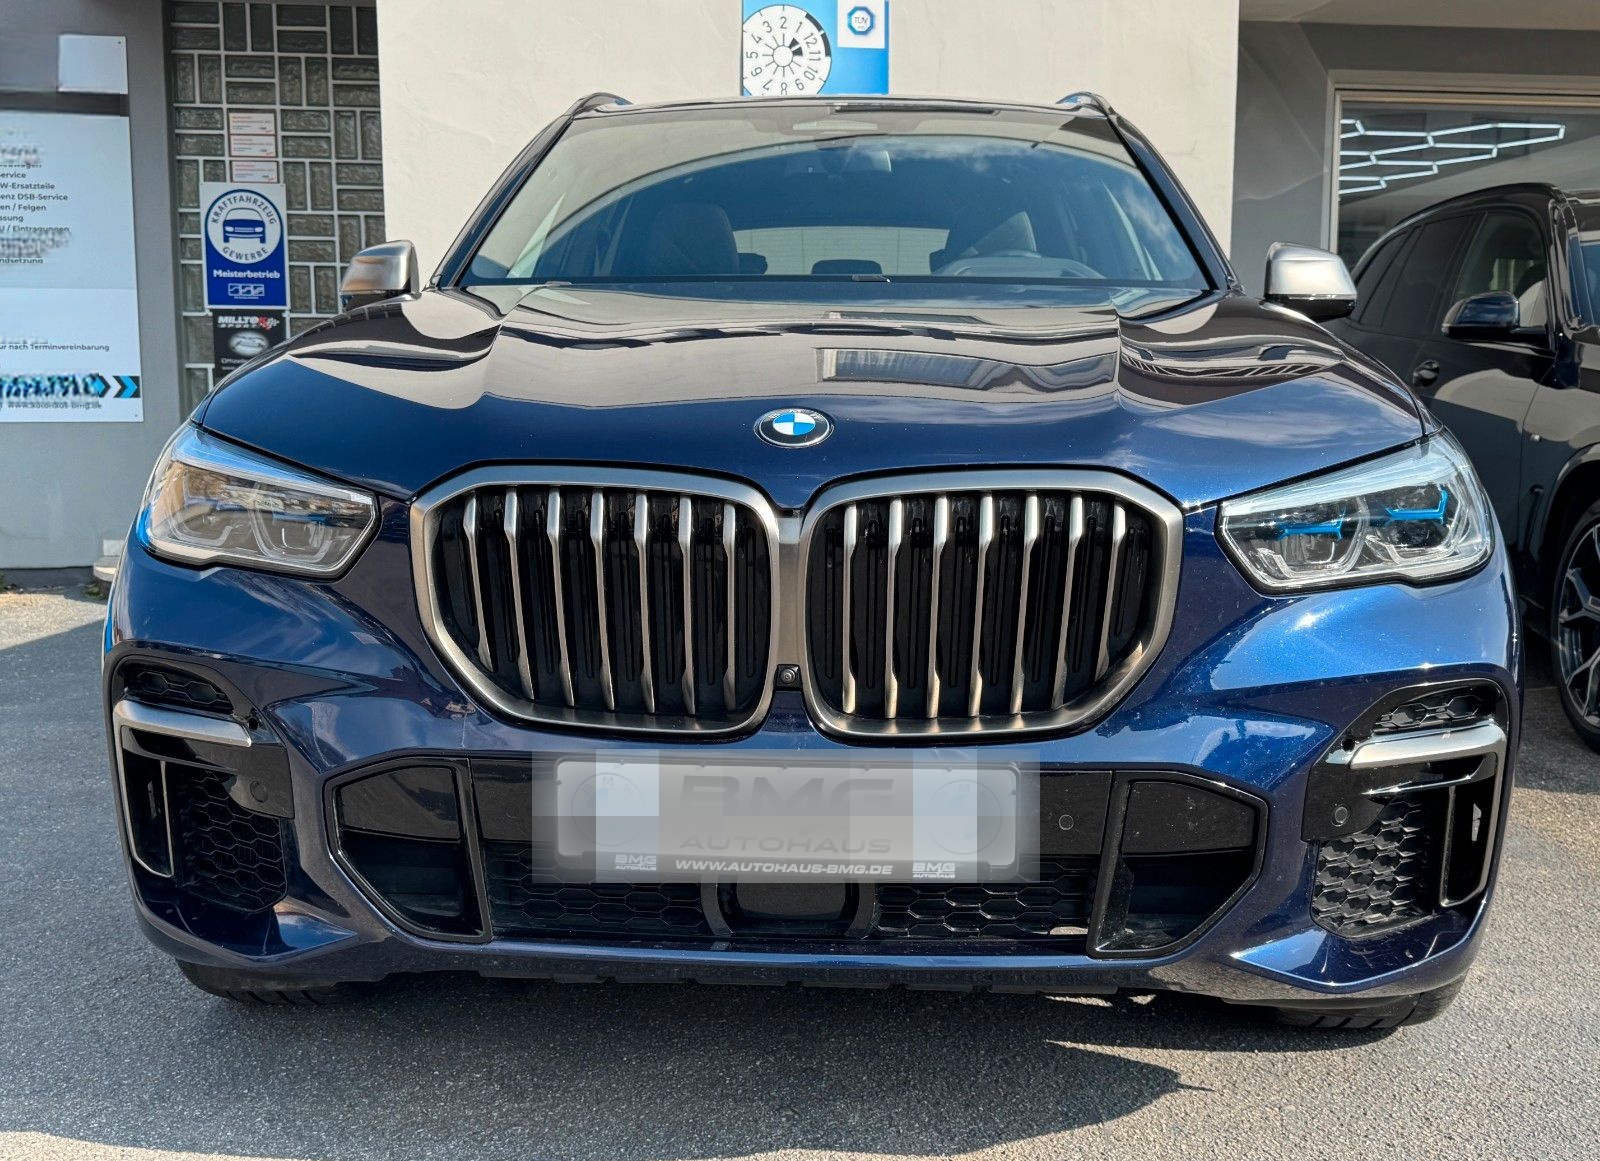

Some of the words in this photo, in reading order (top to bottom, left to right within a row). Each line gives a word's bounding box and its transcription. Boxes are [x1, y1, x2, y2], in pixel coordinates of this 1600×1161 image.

[763, 20, 773, 33] 3
[780, 16, 788, 29] 2
[796, 21, 803, 33] 1
[751, 33, 763, 44] 4
[803, 32, 818, 49] 12
[746, 51, 759, 59] 5
[809, 51, 821, 62] 11
[751, 66, 763, 77] 6
[803, 65, 818, 81] 10
[762, 79, 773, 91] 7
[780, 82, 788, 96] 8
[794, 78, 805, 91] 9
[17, 193, 69, 201] DSB-Service
[18, 204, 47, 212] Felgen
[211, 195, 277, 225] KRAFTFAHRZEUG
[222, 246, 269, 261] GEWERBE
[213, 269, 281, 279] Meisterbetrieb
[30, 344, 110, 352] Terminvereinbarung
[678, 834, 892, 854] AUTOHAUS
[614, 854, 657, 866] BMG
[675, 859, 894, 875] WWW.AUTOHAUS-BMG.DE
[912, 862, 956, 873] BMG
